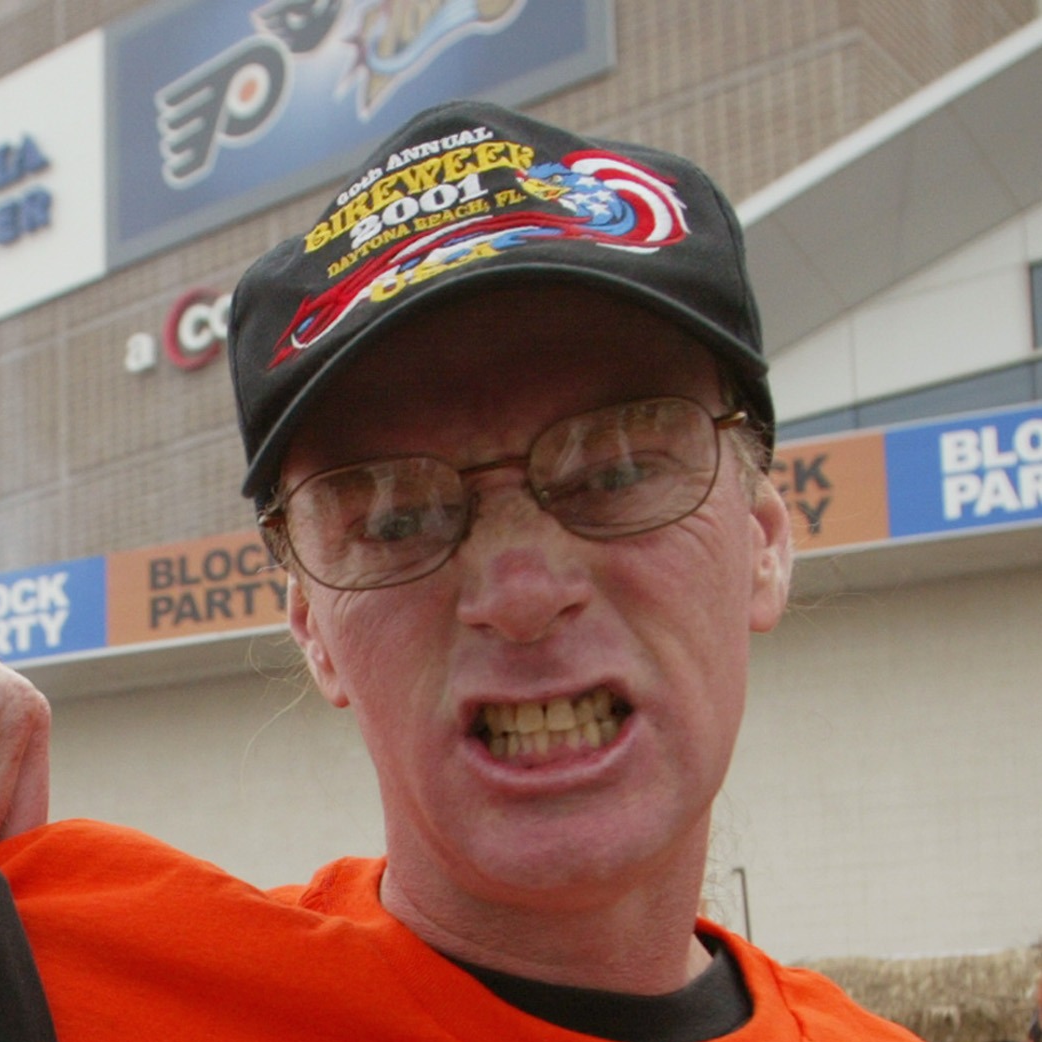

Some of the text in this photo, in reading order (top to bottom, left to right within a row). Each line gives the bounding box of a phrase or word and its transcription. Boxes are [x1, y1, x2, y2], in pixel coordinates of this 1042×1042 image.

[386, 126, 494, 172] ANNUAL
[304, 141, 536, 253] BIKEWEEK
[349, 173, 489, 250] 2001
[327, 222, 411, 279] DAYTONA
[125, 332, 155, 373] a
